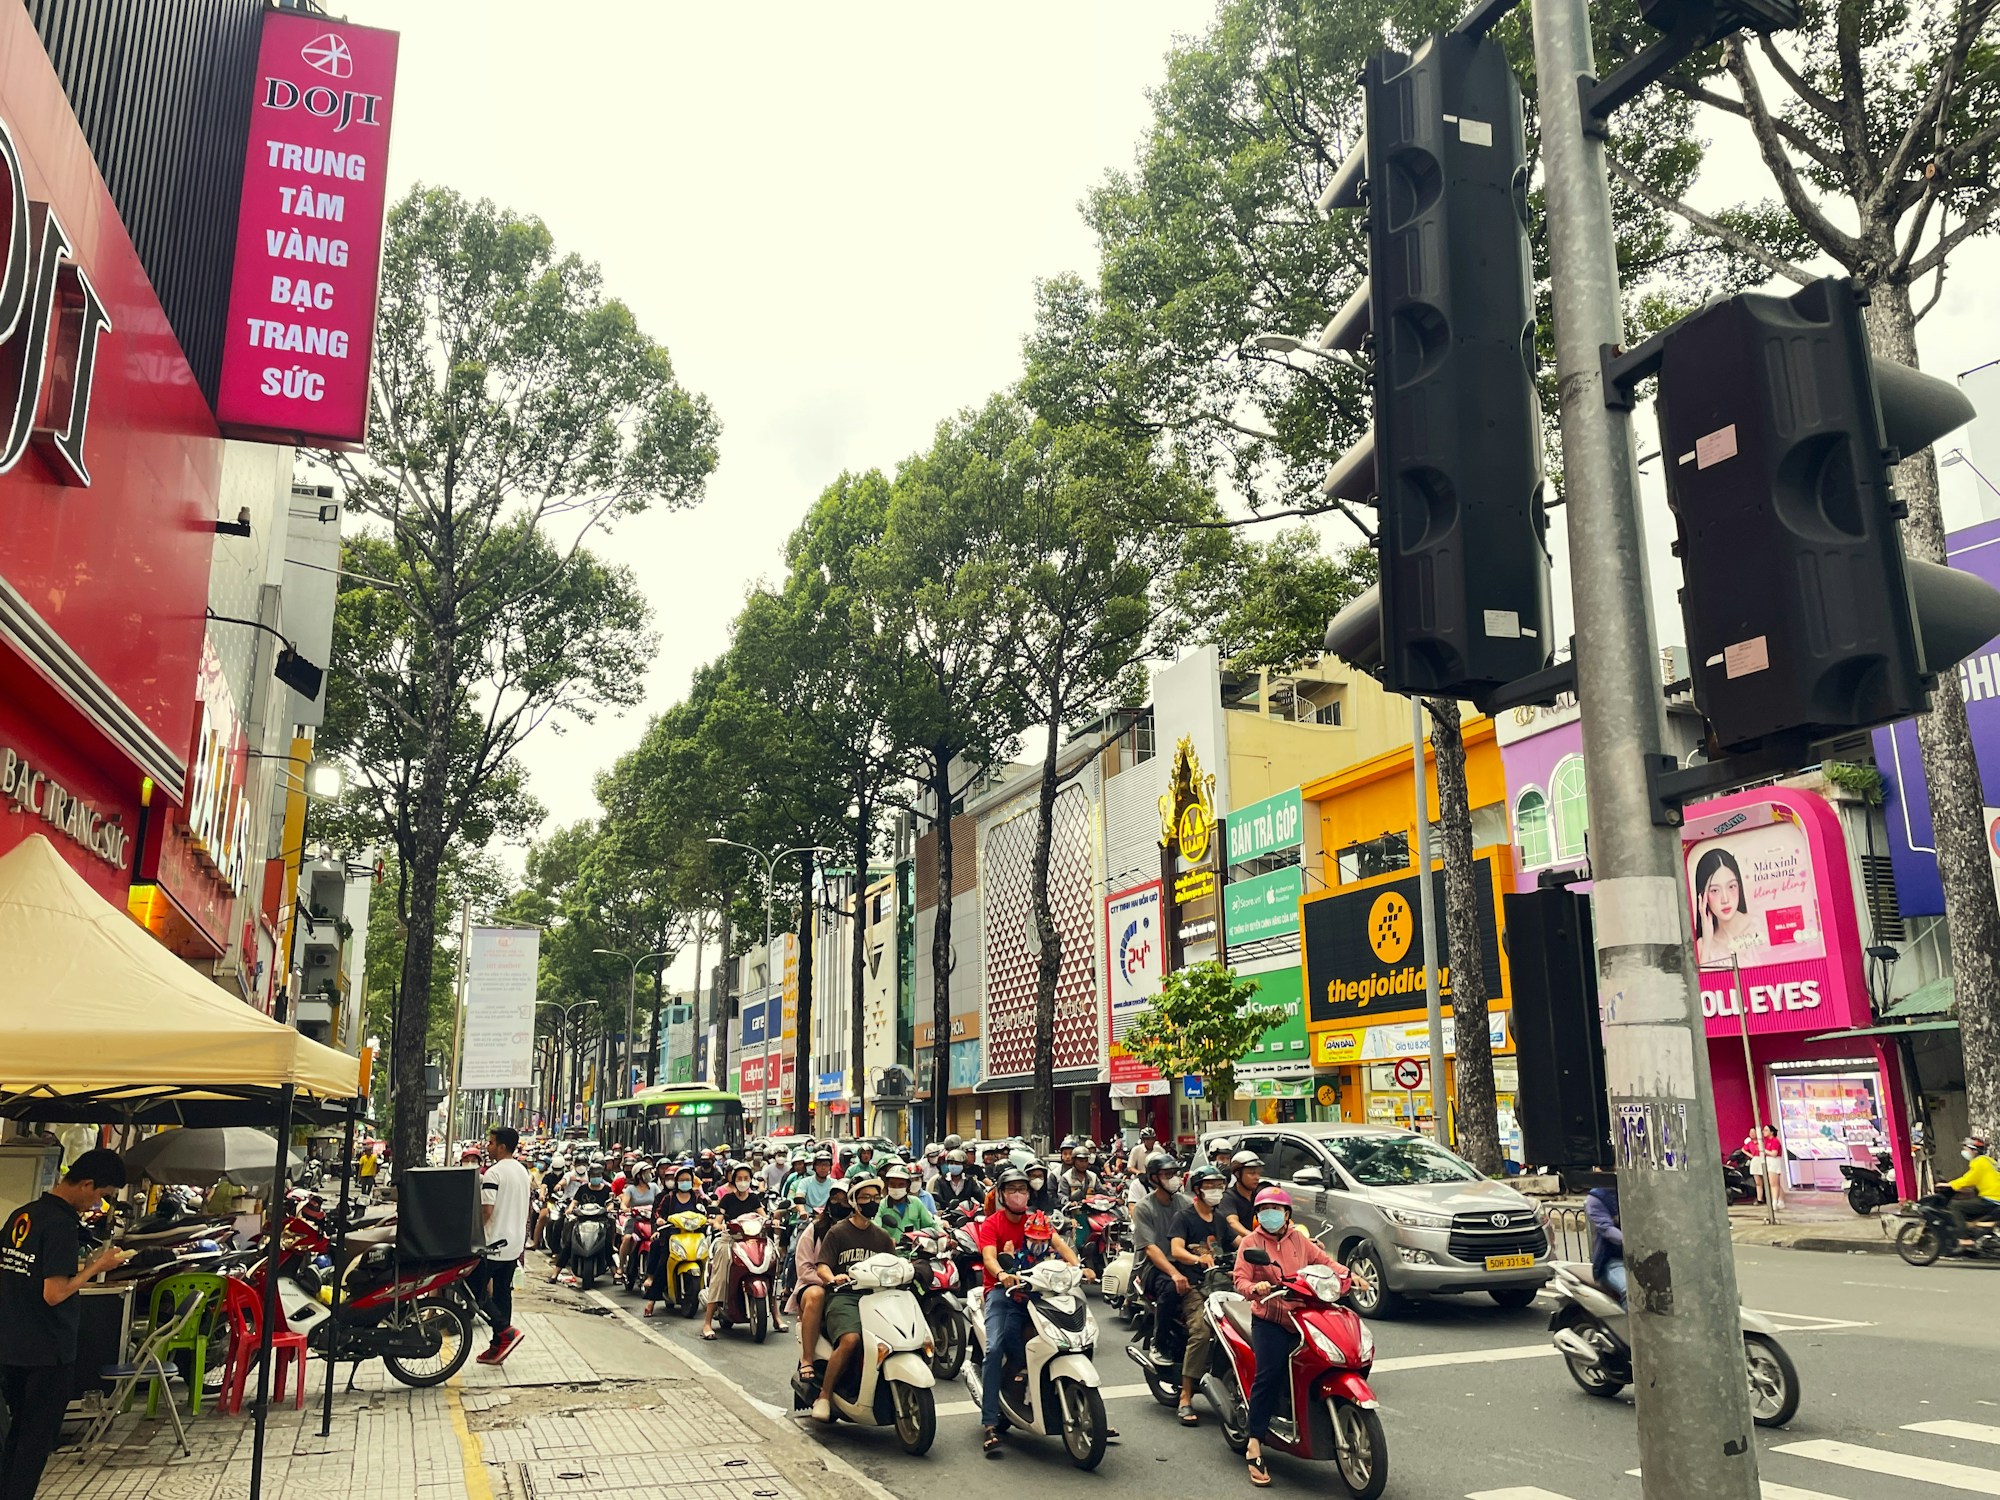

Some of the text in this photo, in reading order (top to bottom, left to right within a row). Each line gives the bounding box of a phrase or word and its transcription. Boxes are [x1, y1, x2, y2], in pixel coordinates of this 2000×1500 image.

[262, 77, 382, 132] DOJI
[266, 140, 365, 181] TRUNG
[279, 185, 345, 222] TÂM
[266, 228, 348, 267] VÀNG
[271, 276, 333, 312] BẠC
[247, 318, 348, 358] TRANG
[260, 365, 325, 401] SỨC
[48, 779, 102, 852] TRANG
[1231, 800, 1297, 858] BÁN TRẢ GÓP
[1774, 855, 1798, 869] xinh
[1128, 940, 1150, 974] 24h
[1700, 980, 1821, 1017] OLL EYES
[665, 1104, 679, 1116] 7
